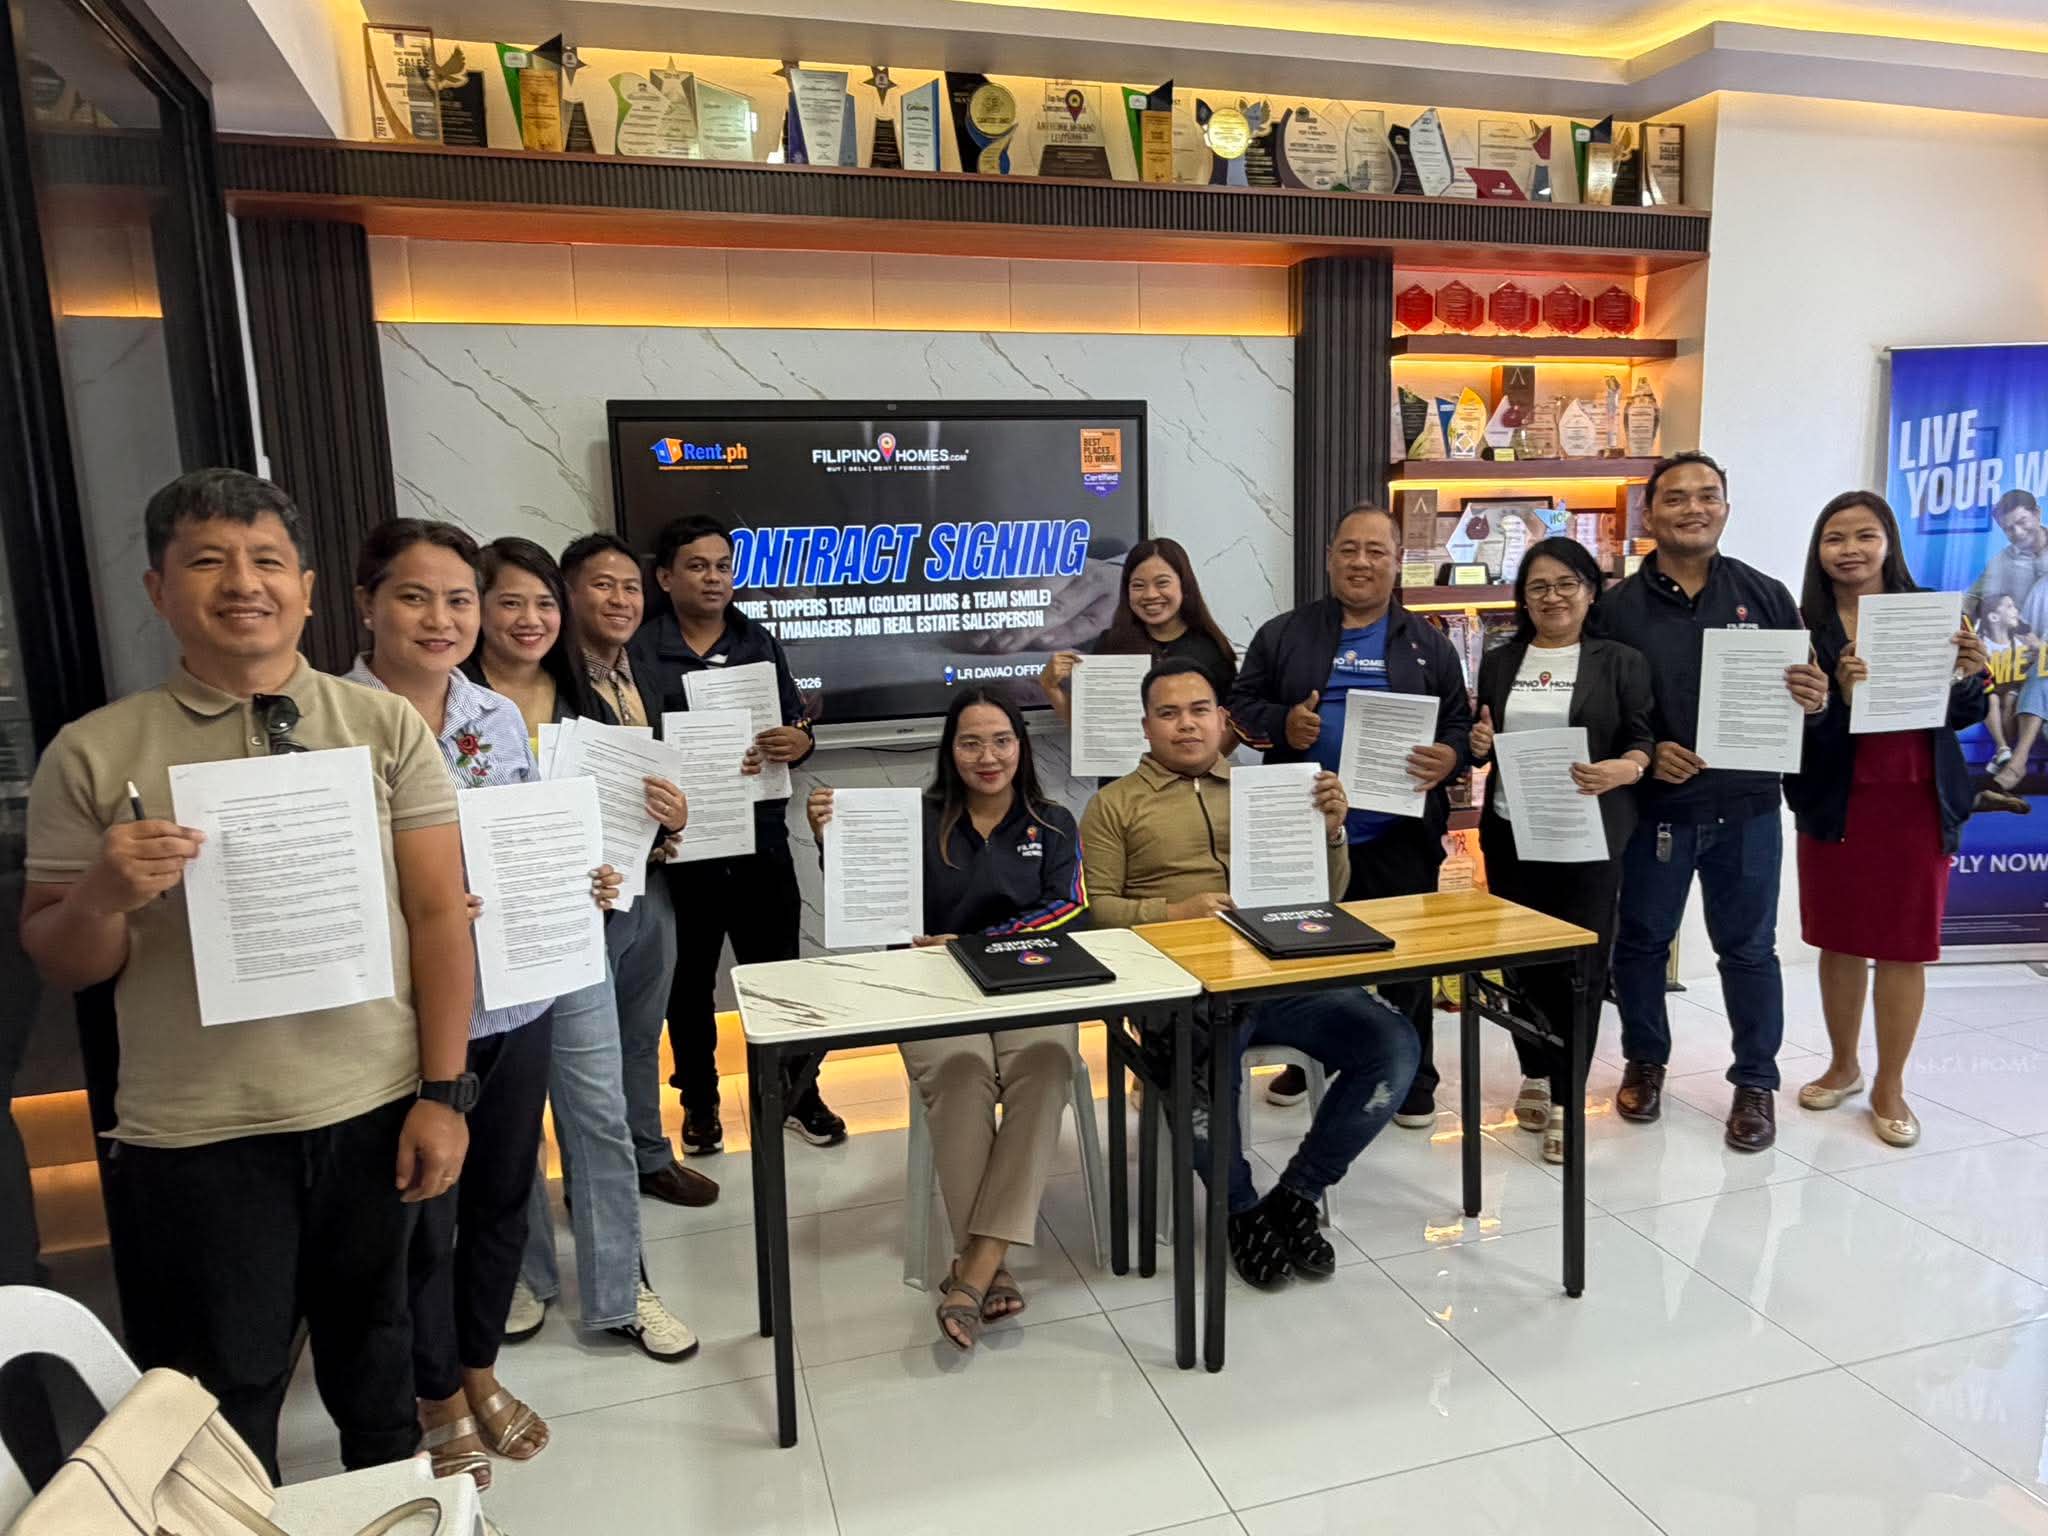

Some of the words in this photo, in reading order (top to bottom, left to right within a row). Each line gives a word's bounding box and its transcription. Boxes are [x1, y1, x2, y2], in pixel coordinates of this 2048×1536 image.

[1899, 409, 1978, 470] LIVE
[683, 443, 748, 463] Rent.ph
[812, 449, 881, 463] FILIPINO
[1906, 458, 2003, 519] YOUR
[2015, 449, 2048, 499] W
[729, 523, 922, 590] ONTRACT
[924, 518, 1091, 582] SIGNING
[733, 600, 769, 619] WIRE
[770, 598, 828, 619] TOPPERS
[829, 596, 866, 616] TEAM
[869, 593, 921, 613] (GOLDEN
[923, 592, 960, 612] LIONS
[961, 593, 971, 610] &
[973, 590, 1008, 609] TEAM
[1010, 589, 1051, 607] SMILE)
[780, 618, 852, 640] MANAGERS
[855, 617, 881, 637] AND
[884, 614, 914, 635] REAL
[916, 613, 960, 633] ESTATE
[962, 610, 1044, 631] SALESPERSON
[957, 668, 973, 680] LR
[975, 666, 1013, 679] DAVAO
[1015, 664, 1046, 676] OFFI
[1355, 659, 1385, 667] HOME
[1990, 645, 2029, 684] ME
[1511, 680, 1540, 688] PINO
[1551, 680, 1576, 688] HOM
[1949, 855, 1984, 873] PLY
[1990, 853, 2048, 873] NOW
